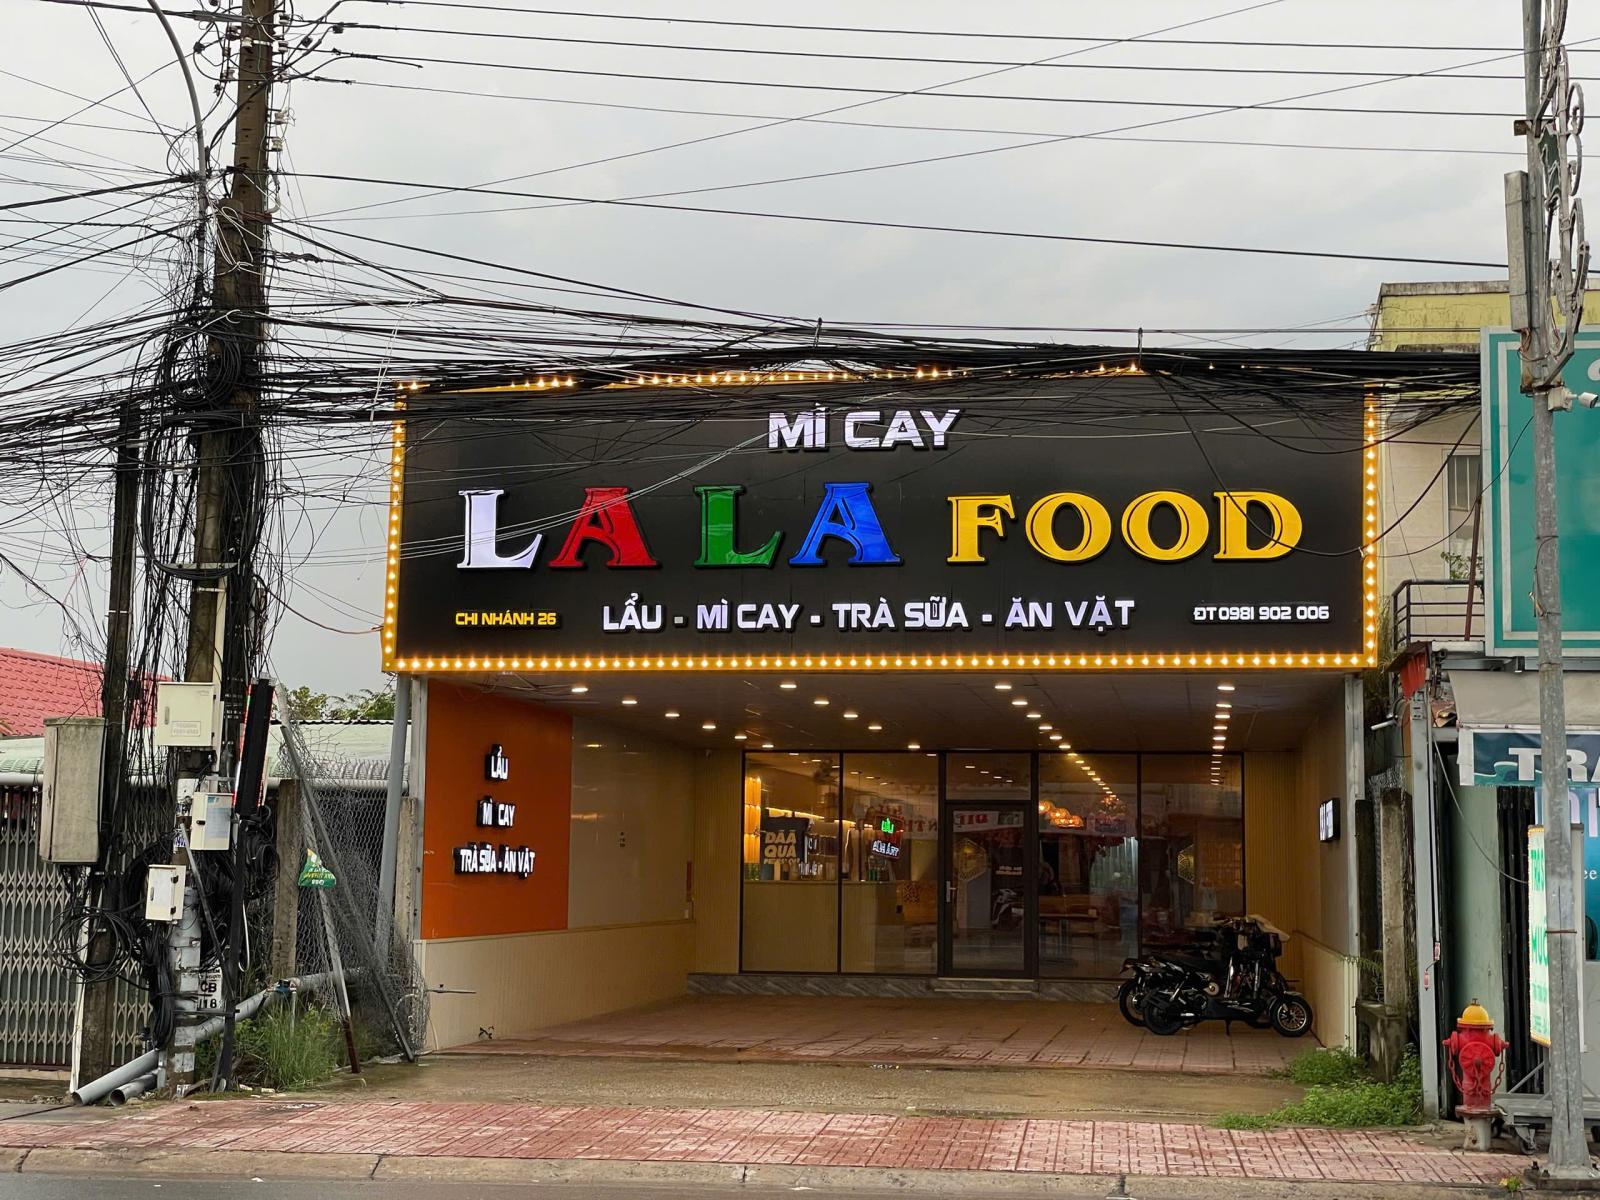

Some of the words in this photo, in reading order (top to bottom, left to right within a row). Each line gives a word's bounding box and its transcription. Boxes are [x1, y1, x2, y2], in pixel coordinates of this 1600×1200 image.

[843, 407, 961, 449] CAY
[457, 487, 655, 569] LA
[695, 482, 899, 566] LA
[946, 490, 1304, 564] FOOD
[455, 612, 478, 625] CHI
[481, 609, 534, 626] NHÁNH
[537, 612, 557, 625] 26
[602, 592, 663, 631] LẨU
[697, 598, 728, 629] MÌ
[737, 603, 800, 629] CAY
[831, 596, 895, 628] TRÀ
[904, 596, 969, 628] SỮA
[1004, 596, 1053, 628] ĂN
[1064, 595, 1135, 632] VẶT
[1258, 606, 1292, 620] 902
[1296, 606, 1330, 620] 006
[498, 803, 516, 827] CAY
[460, 844, 478, 873] TRÀ
